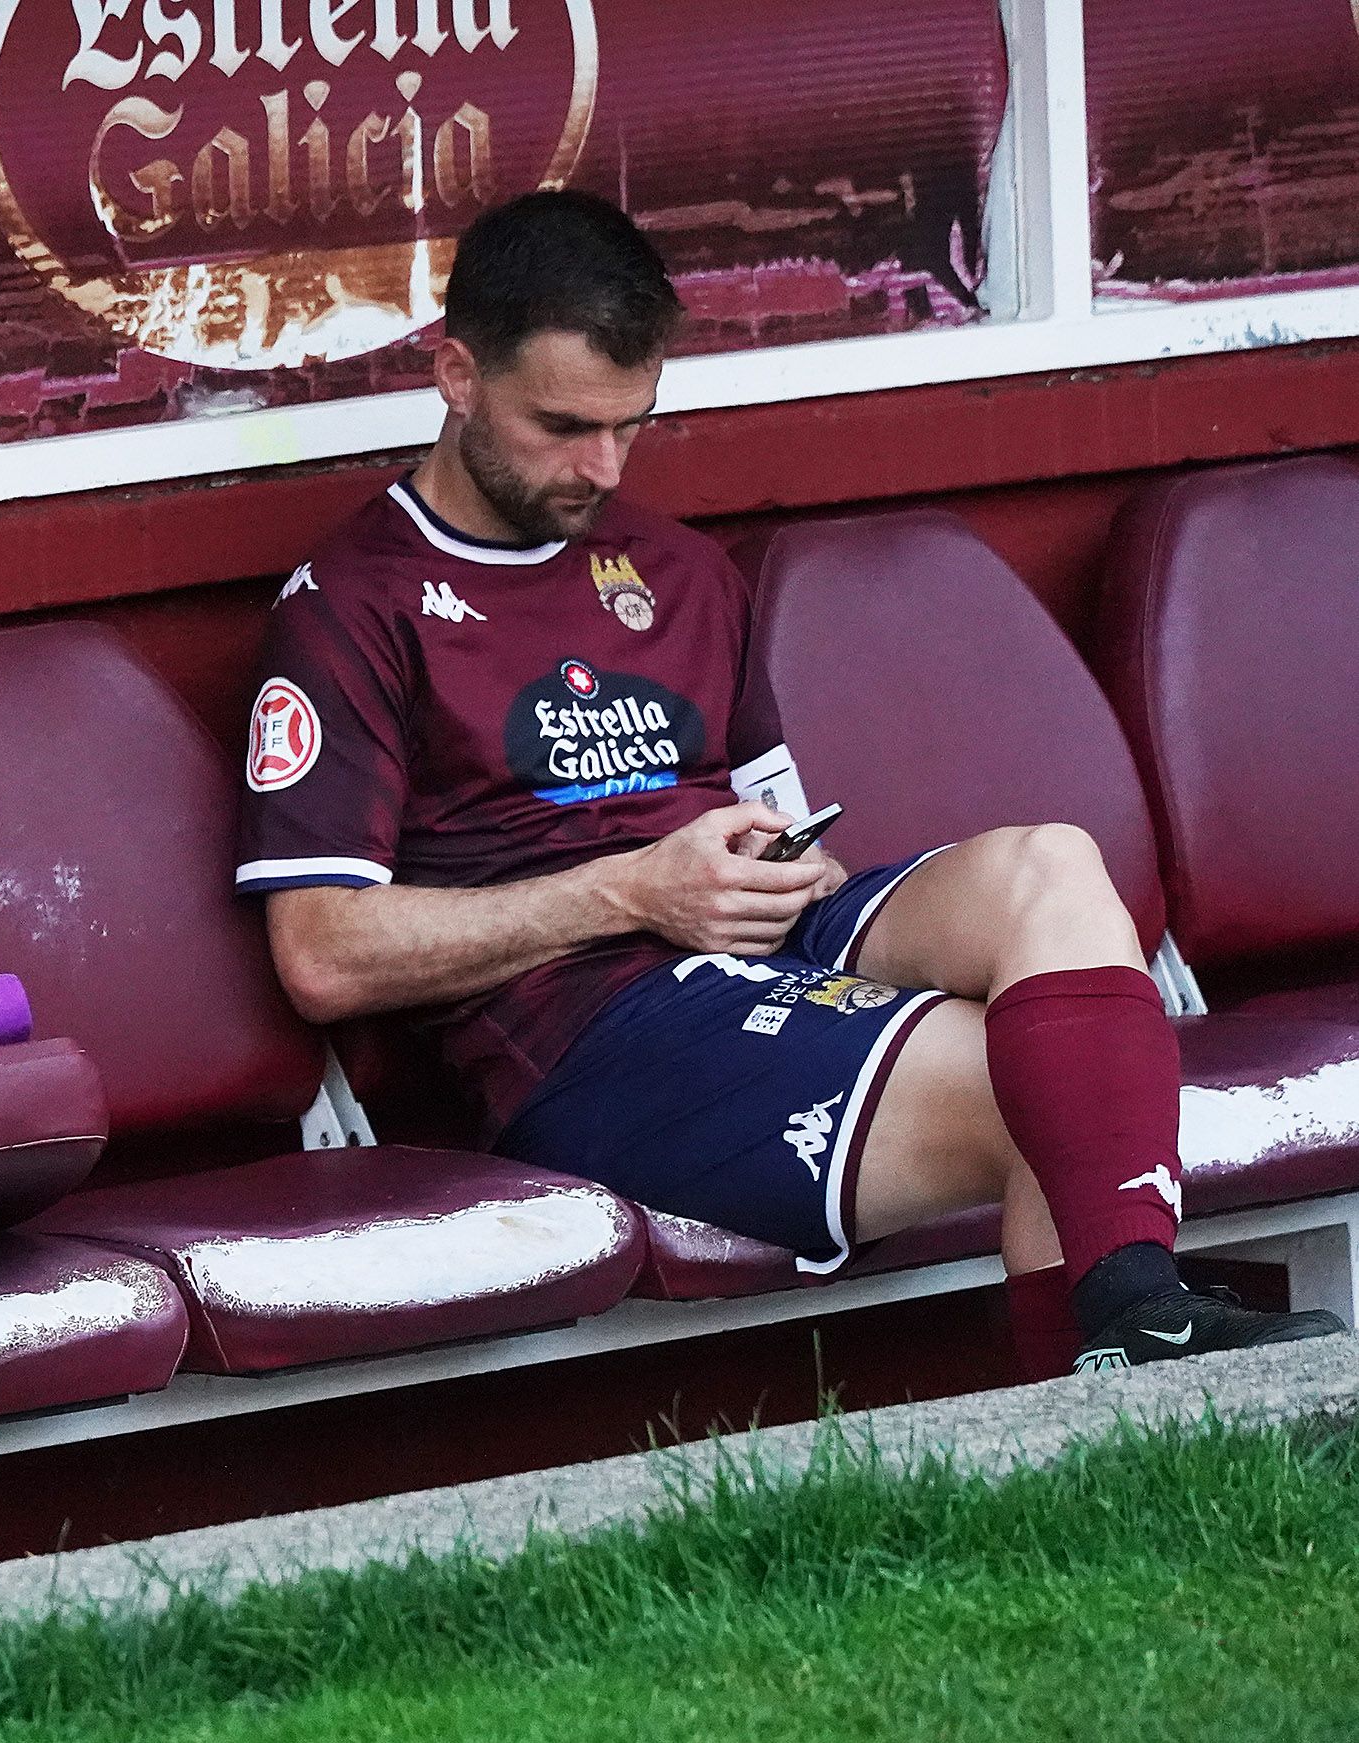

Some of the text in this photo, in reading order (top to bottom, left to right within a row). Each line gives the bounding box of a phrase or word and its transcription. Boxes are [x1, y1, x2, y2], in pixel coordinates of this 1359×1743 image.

[88, 71, 498, 242] Galicia
[534, 696, 670, 738] Estrella
[548, 735, 680, 781] Galicia
